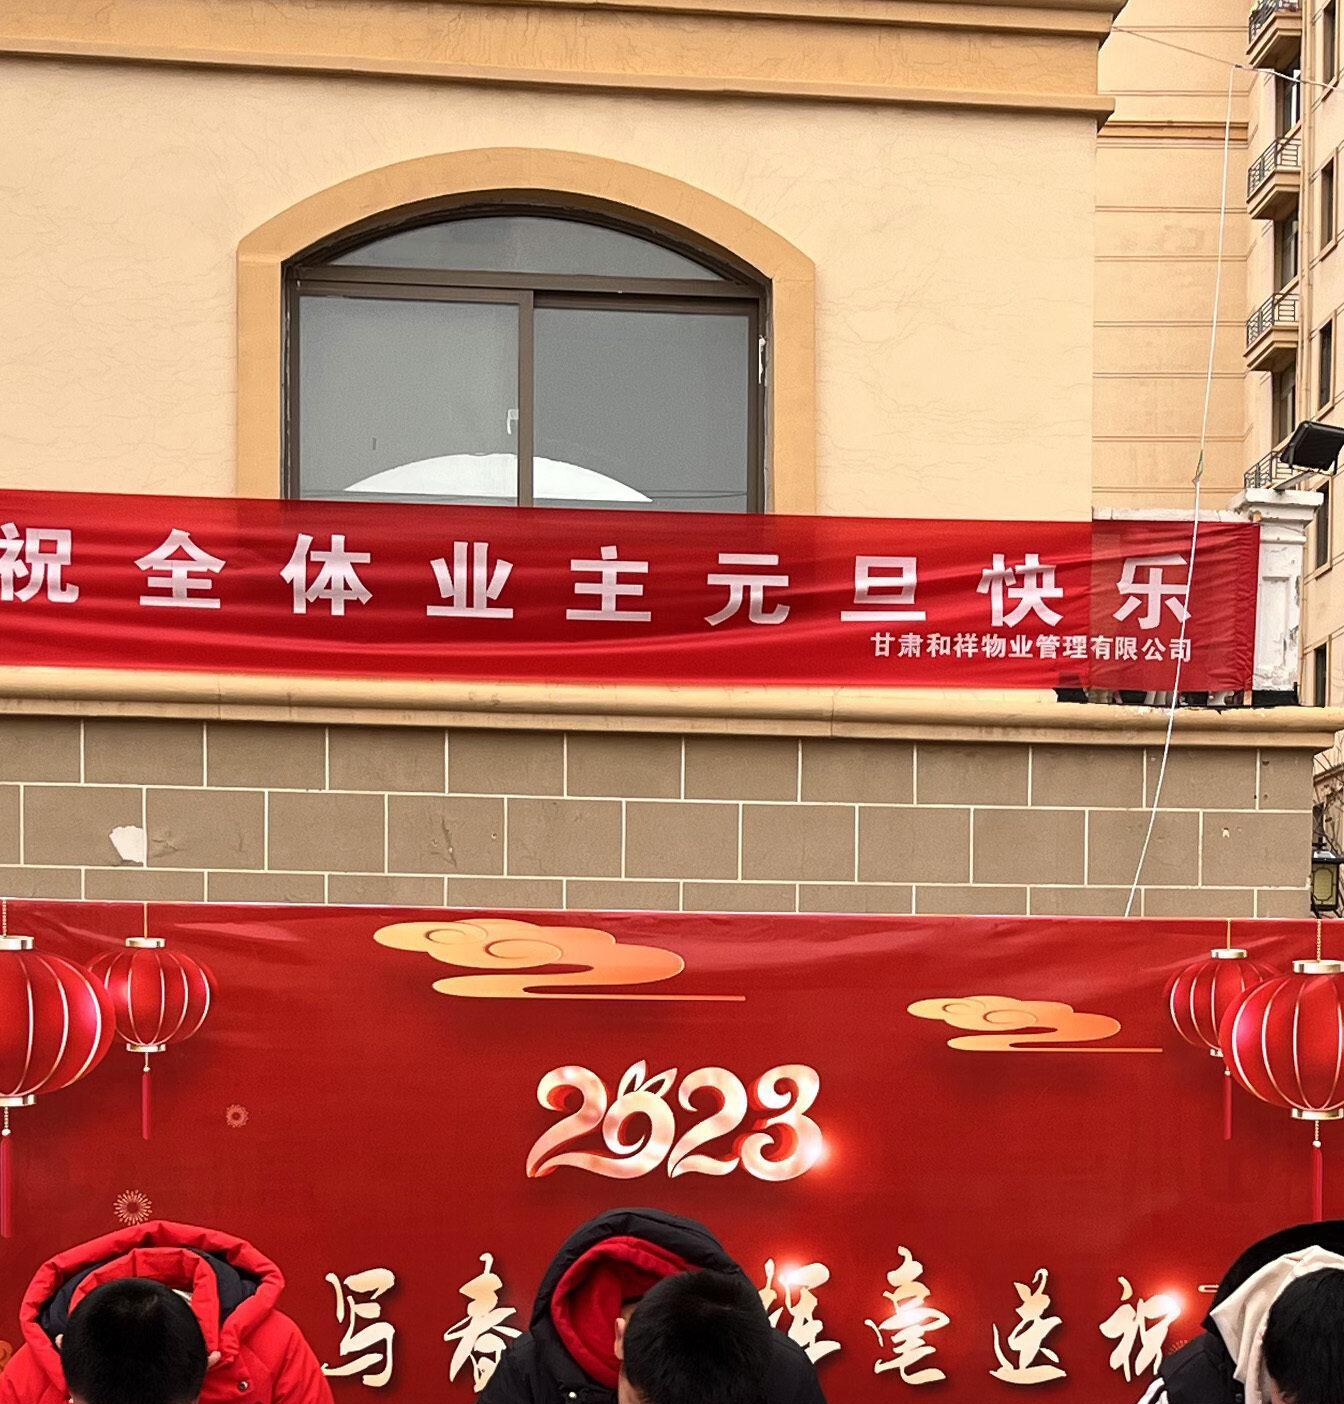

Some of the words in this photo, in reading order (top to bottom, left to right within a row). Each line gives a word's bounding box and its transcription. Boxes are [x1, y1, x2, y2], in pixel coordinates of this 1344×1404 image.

[870, 632, 1192, 663] 甘肃和祥物业管理有限公司
[526, 1060, 824, 1182] 2023
